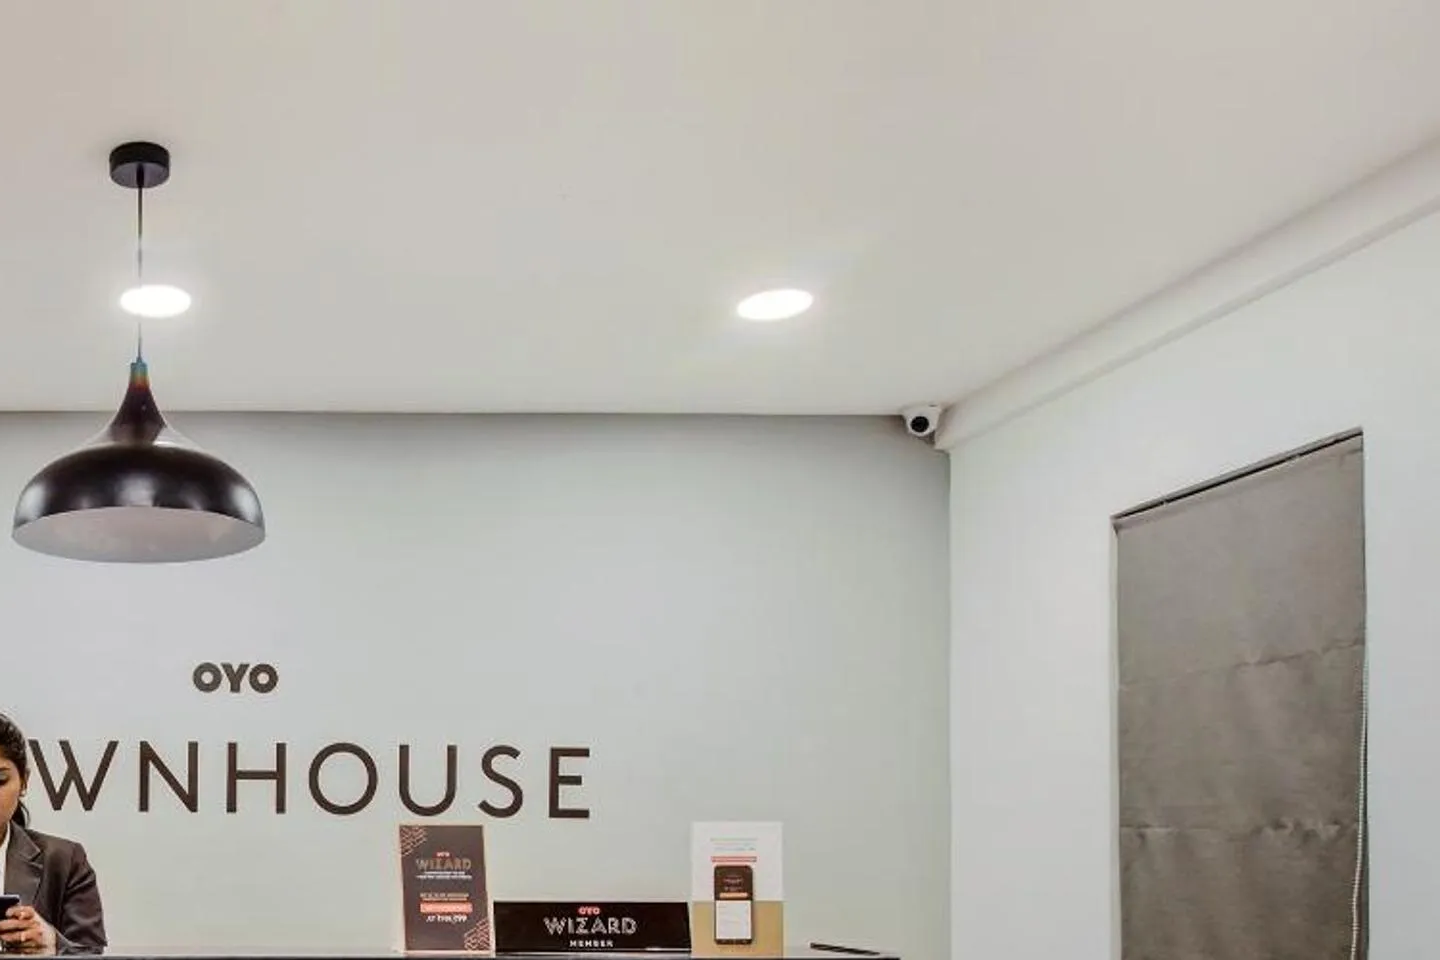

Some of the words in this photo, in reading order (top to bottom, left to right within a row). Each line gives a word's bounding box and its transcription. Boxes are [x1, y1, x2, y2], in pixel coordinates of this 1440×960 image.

[192, 662, 279, 693] OYO
[415, 858, 472, 871] WIZARD
[578, 906, 601, 915] OYO
[543, 917, 637, 935] WIZARD
[569, 940, 614, 948] MEMBER
